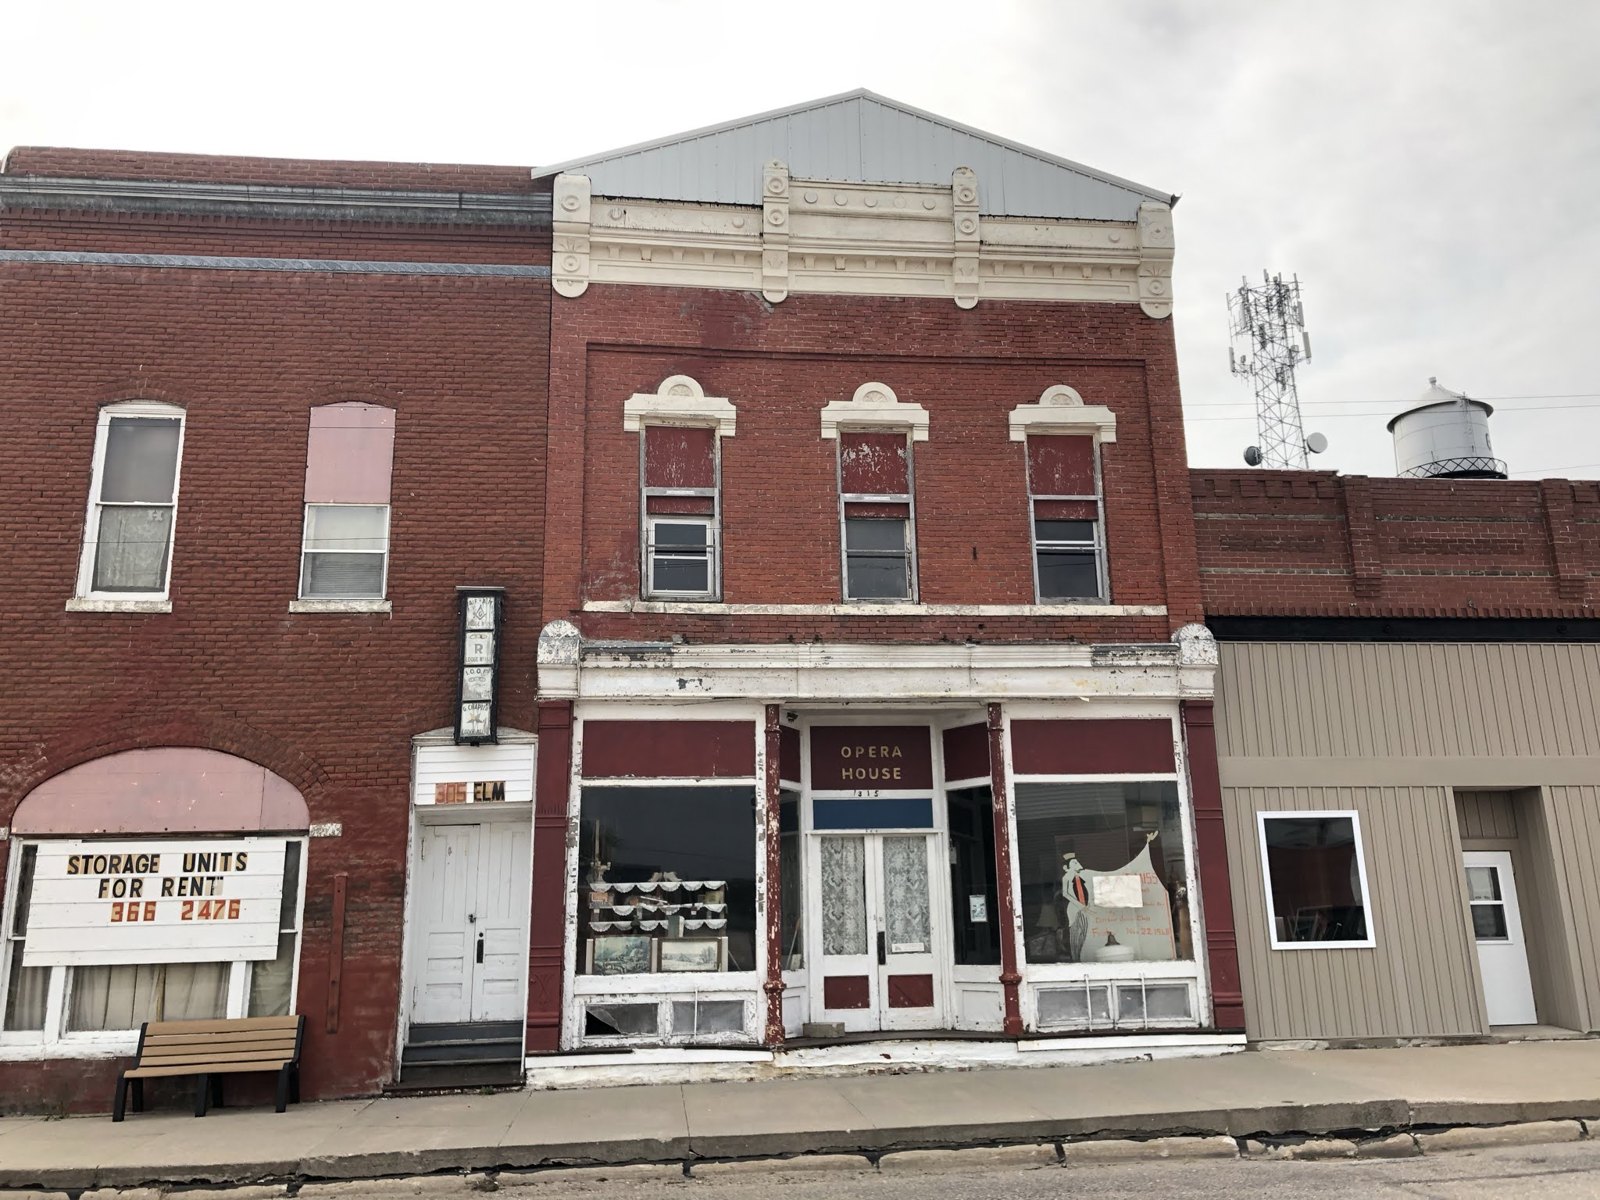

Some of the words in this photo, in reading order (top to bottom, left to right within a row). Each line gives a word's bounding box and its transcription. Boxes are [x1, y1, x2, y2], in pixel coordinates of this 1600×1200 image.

[841, 746, 902, 758] OPERA
[842, 767, 902, 780] HOUSE
[474, 781, 505, 802] ELM
[67, 854, 159, 875] STORAGE
[182, 851, 248, 873] UNITS
[98, 878, 143, 899] FOR
[111, 901, 157, 922] 366
[181, 900, 241, 920] 2476
